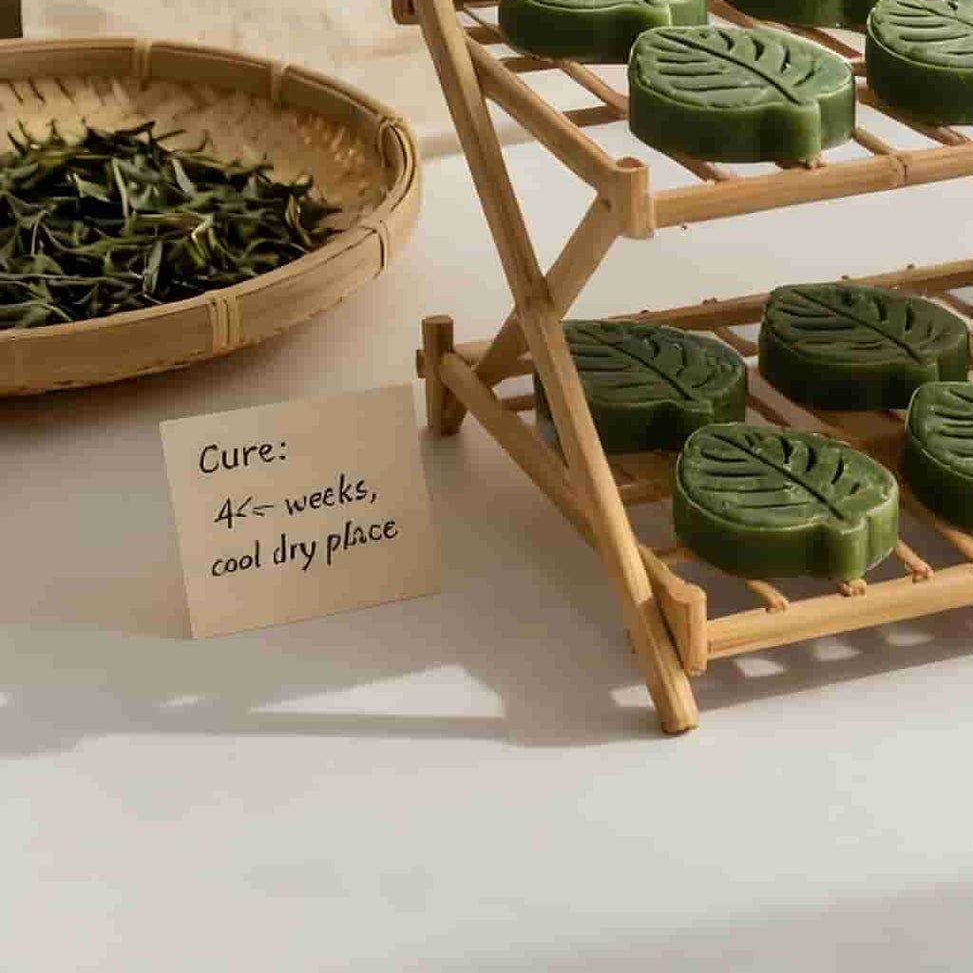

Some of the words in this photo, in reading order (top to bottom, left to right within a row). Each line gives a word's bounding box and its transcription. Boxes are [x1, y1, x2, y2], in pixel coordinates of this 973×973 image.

[199, 441, 287, 473] Cure:
[285, 473, 377, 515] weeks,
[211, 539, 261, 576] cool
[273, 532, 317, 571] dry
[326, 520, 399, 566] place
